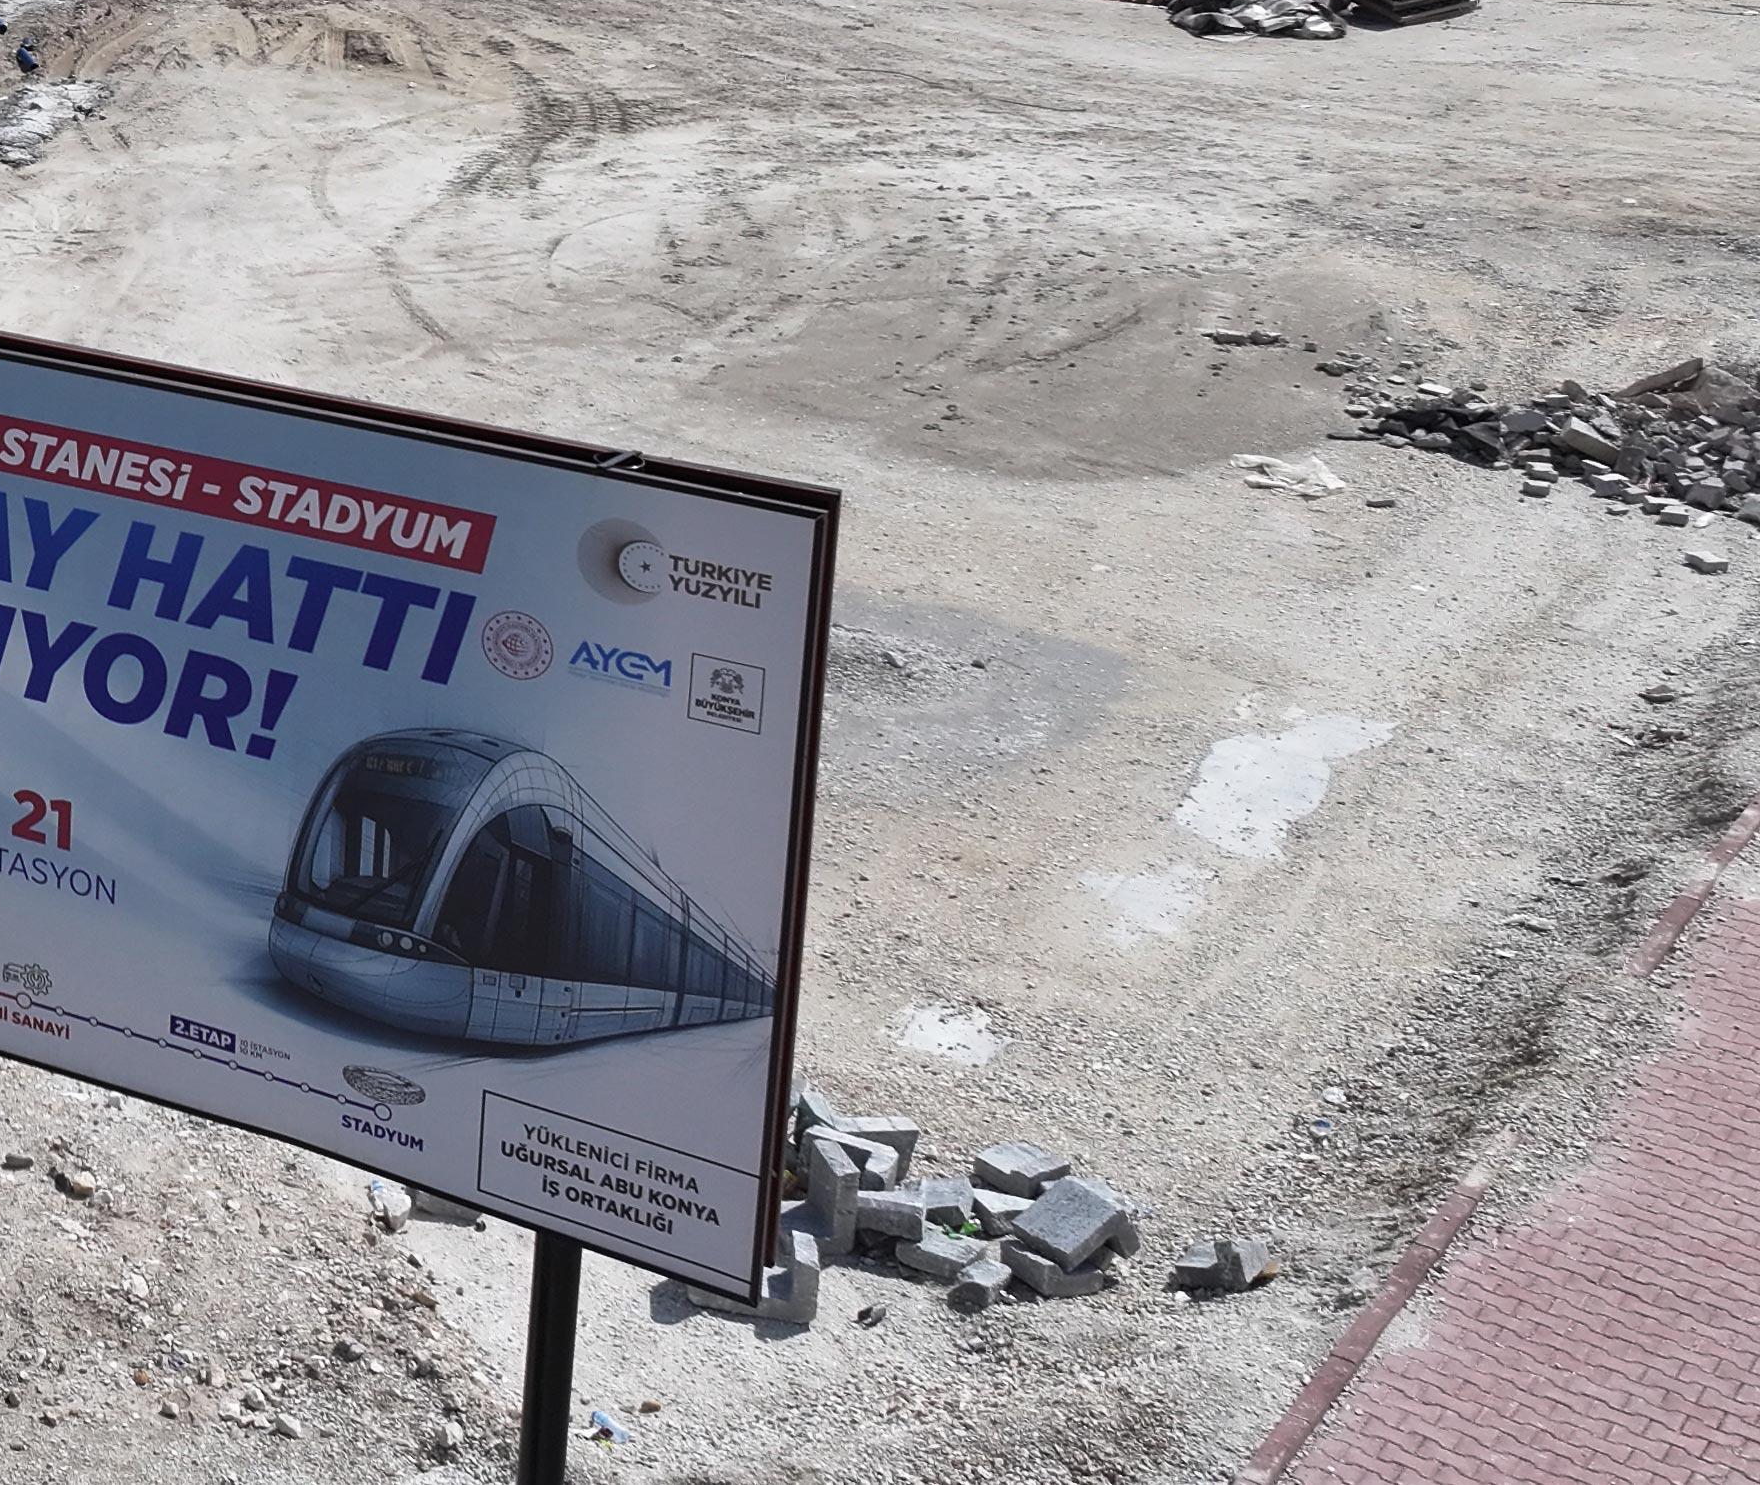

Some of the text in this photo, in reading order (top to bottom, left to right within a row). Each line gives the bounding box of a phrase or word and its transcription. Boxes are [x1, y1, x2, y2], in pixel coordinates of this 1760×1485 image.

[202, 483, 221, 496] -
[233, 475, 472, 560] STADYUM
[107, 520, 477, 685] HATTI
[695, 698, 755, 719] BÜYÜKŞEHİR
[711, 694, 740, 706] KONYA
[12, 789, 72, 852] 21
[11, 1011, 71, 1040] SANAYİ
[175, 1020, 232, 1047] 2.ETAP
[250, 1040, 291, 1060] İSTASYON
[342, 1115, 424, 1152] STADYUM
[500, 1140, 720, 1226] UĞURSAL ABU KONYA
[523, 1124, 699, 1195] YÜKLENİCİ FİRMA
[542, 1174, 673, 1235] İŞ ORTAKLIĞI
